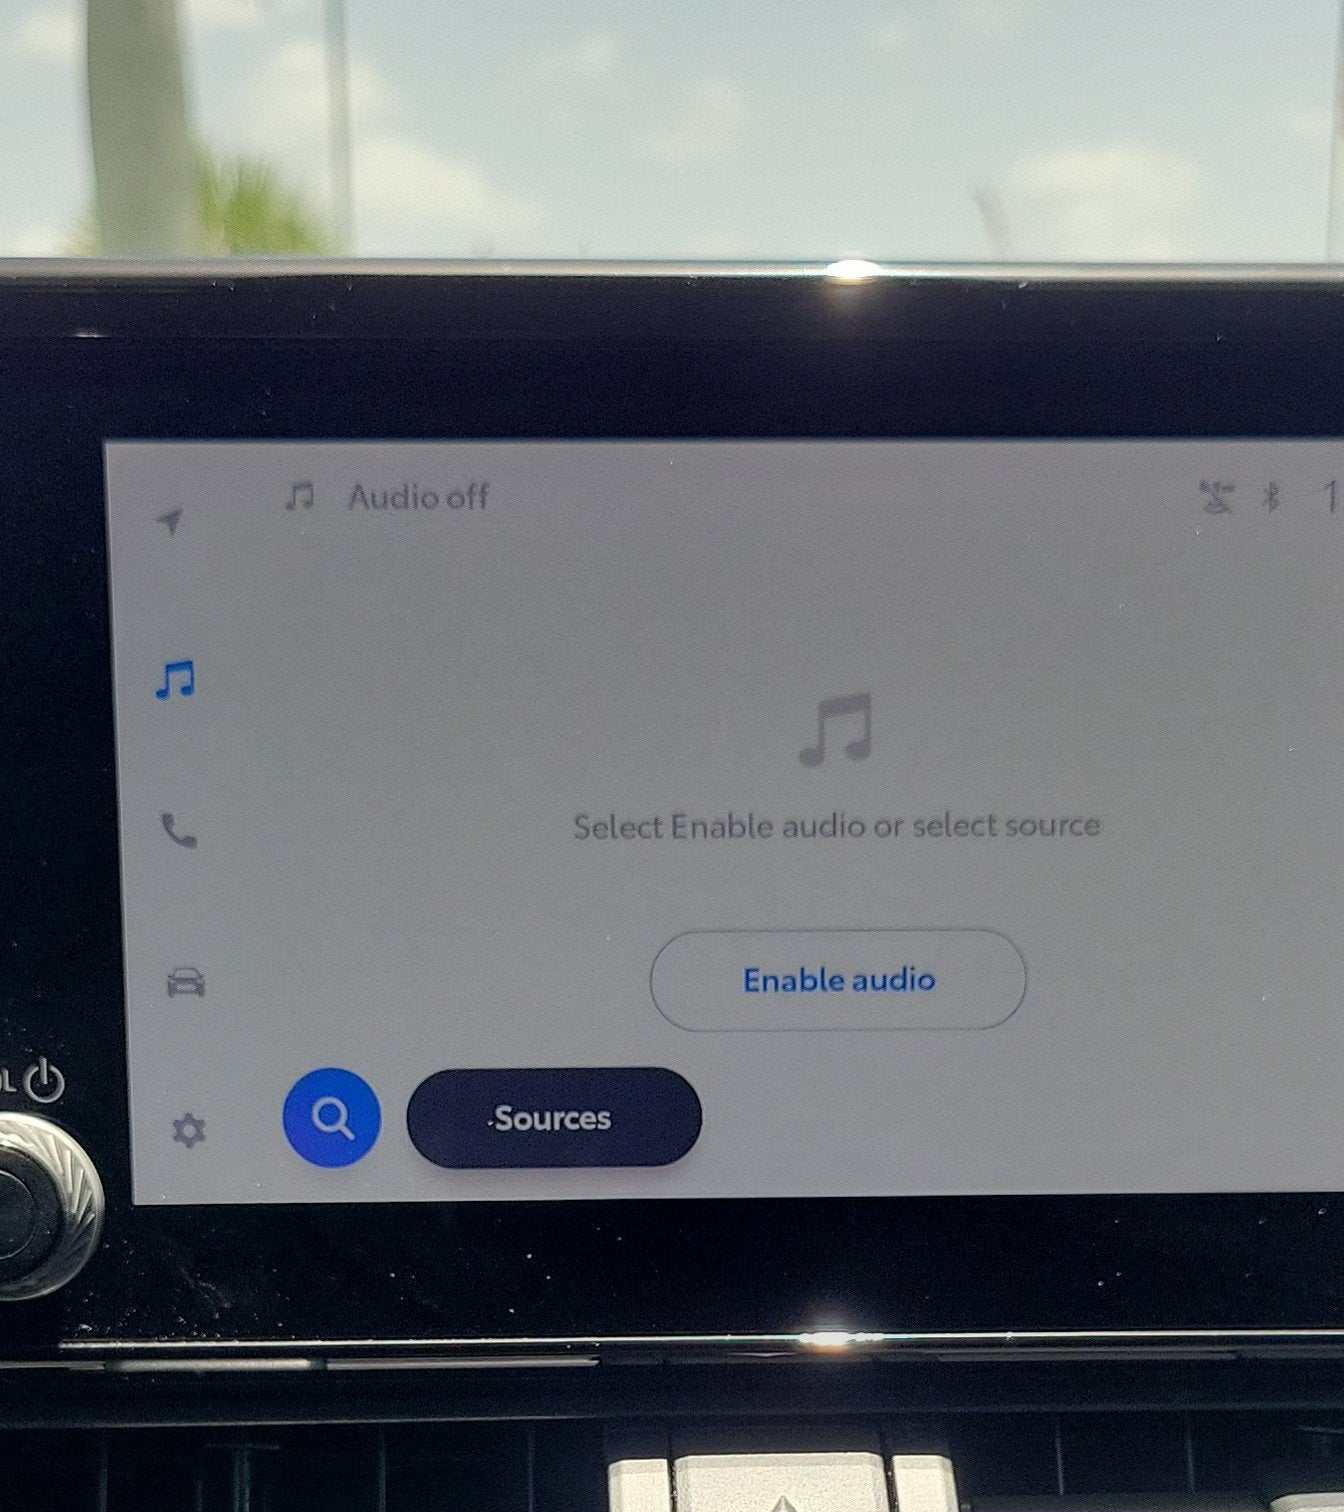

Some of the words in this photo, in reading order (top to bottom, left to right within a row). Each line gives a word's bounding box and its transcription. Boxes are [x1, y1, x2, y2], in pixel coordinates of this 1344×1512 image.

[347, 481, 439, 511] Audio
[446, 481, 489, 510] off
[574, 813, 663, 840] Select
[671, 812, 774, 839] Enable
[782, 811, 866, 839] audio
[873, 816, 904, 838] or
[913, 811, 1000, 838] select
[1005, 815, 1101, 838] source
[744, 967, 845, 993] Enable
[852, 965, 937, 993] audio
[494, 1103, 612, 1132] Sources
